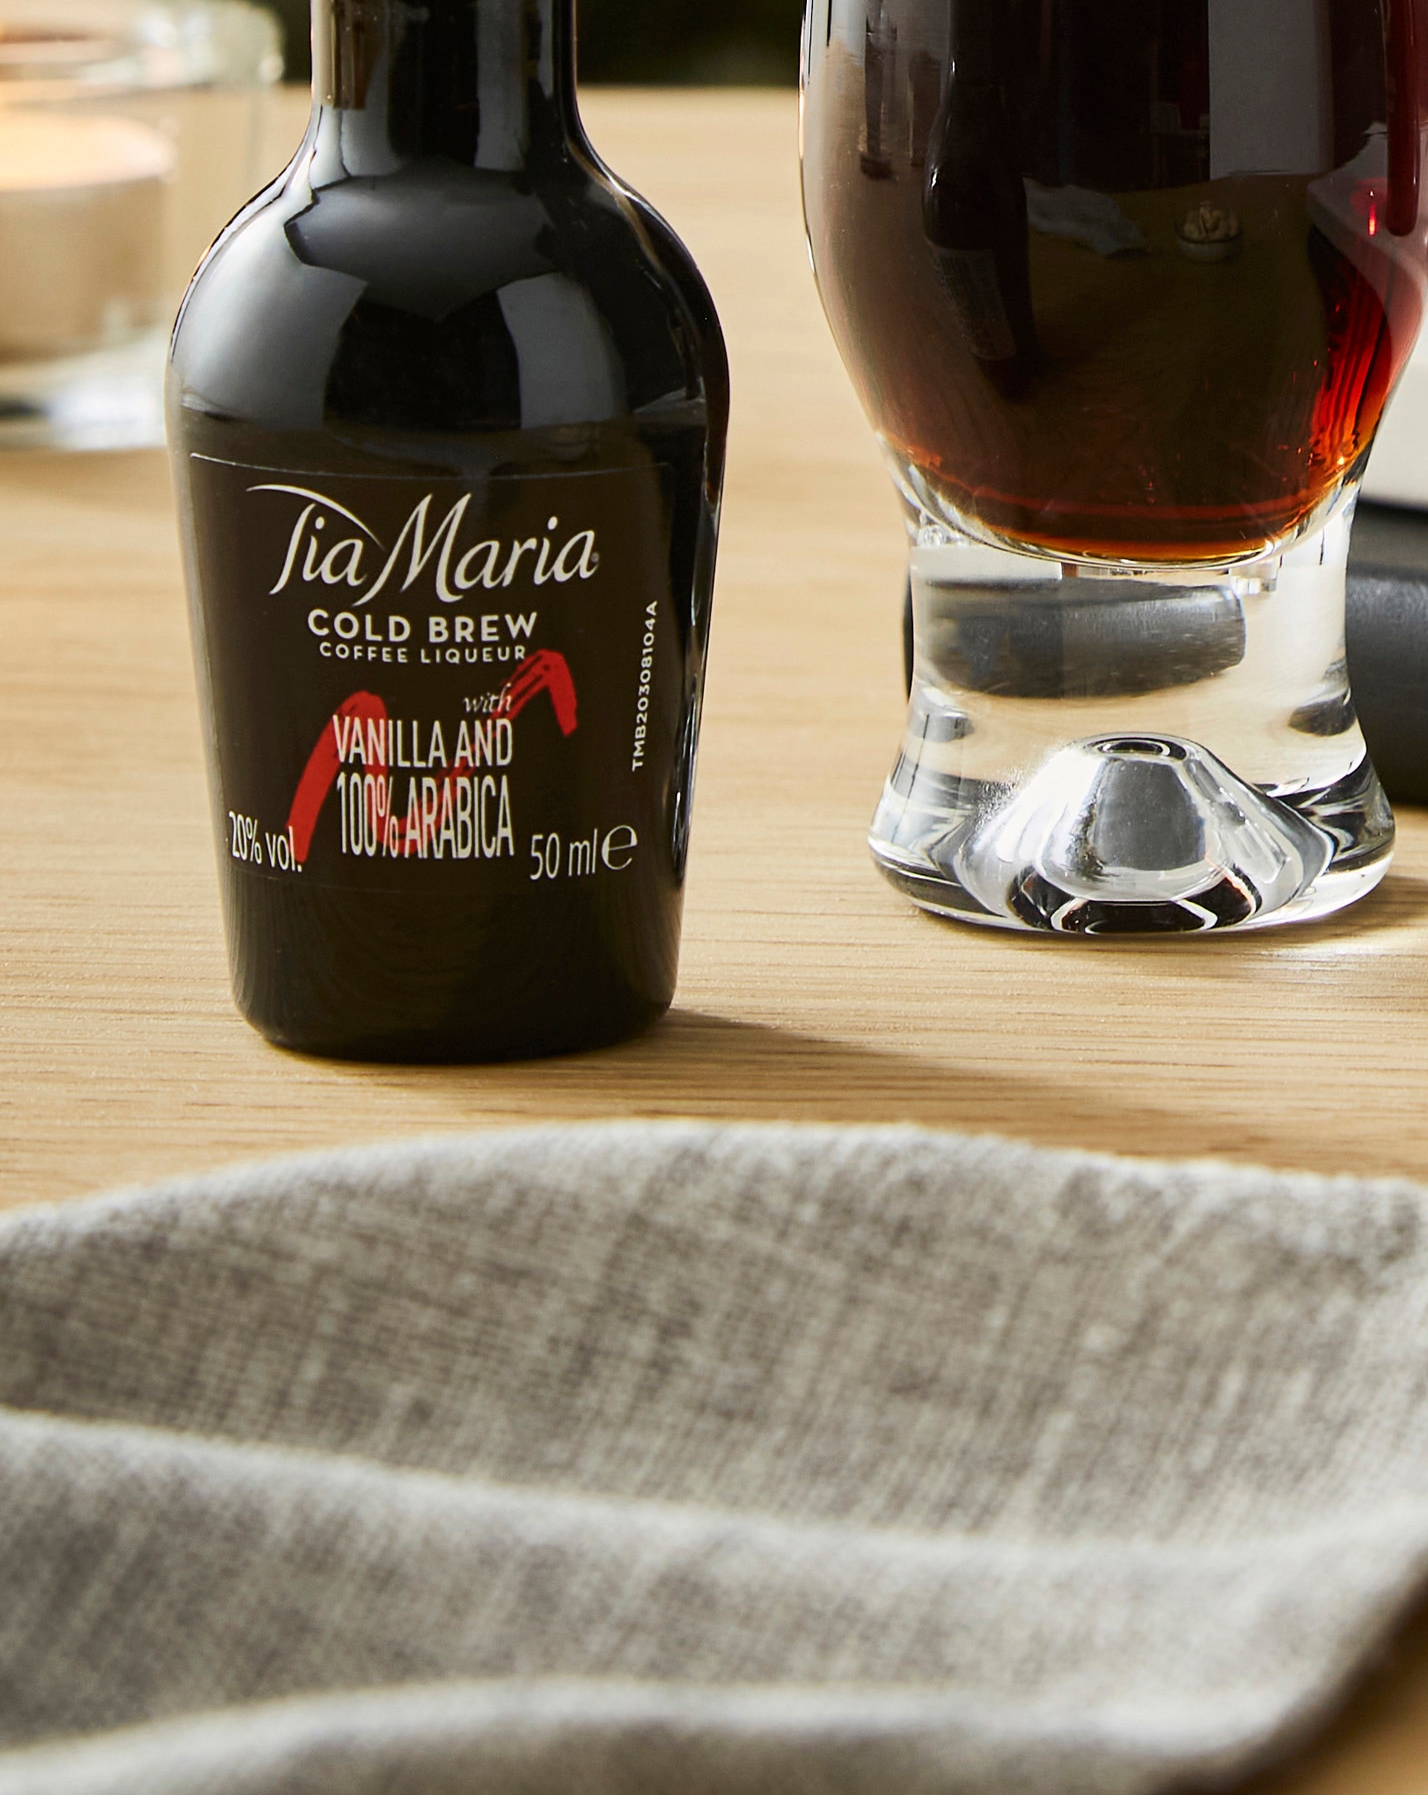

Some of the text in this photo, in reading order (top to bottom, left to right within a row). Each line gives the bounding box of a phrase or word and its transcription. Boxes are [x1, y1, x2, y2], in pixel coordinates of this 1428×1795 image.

[246, 483, 599, 607] Tia Maria
[307, 608, 538, 644] COLD BREW
[319, 641, 526, 665] COFFEE LIQUEUR
[462, 681, 513, 714] with
[630, 599, 659, 773] TMB20308104A
[332, 713, 513, 768] VANILLA AND
[228, 810, 303, 873] 20% vol.
[336, 771, 515, 860] 100% ARABICA
[529, 831, 561, 881] 50
